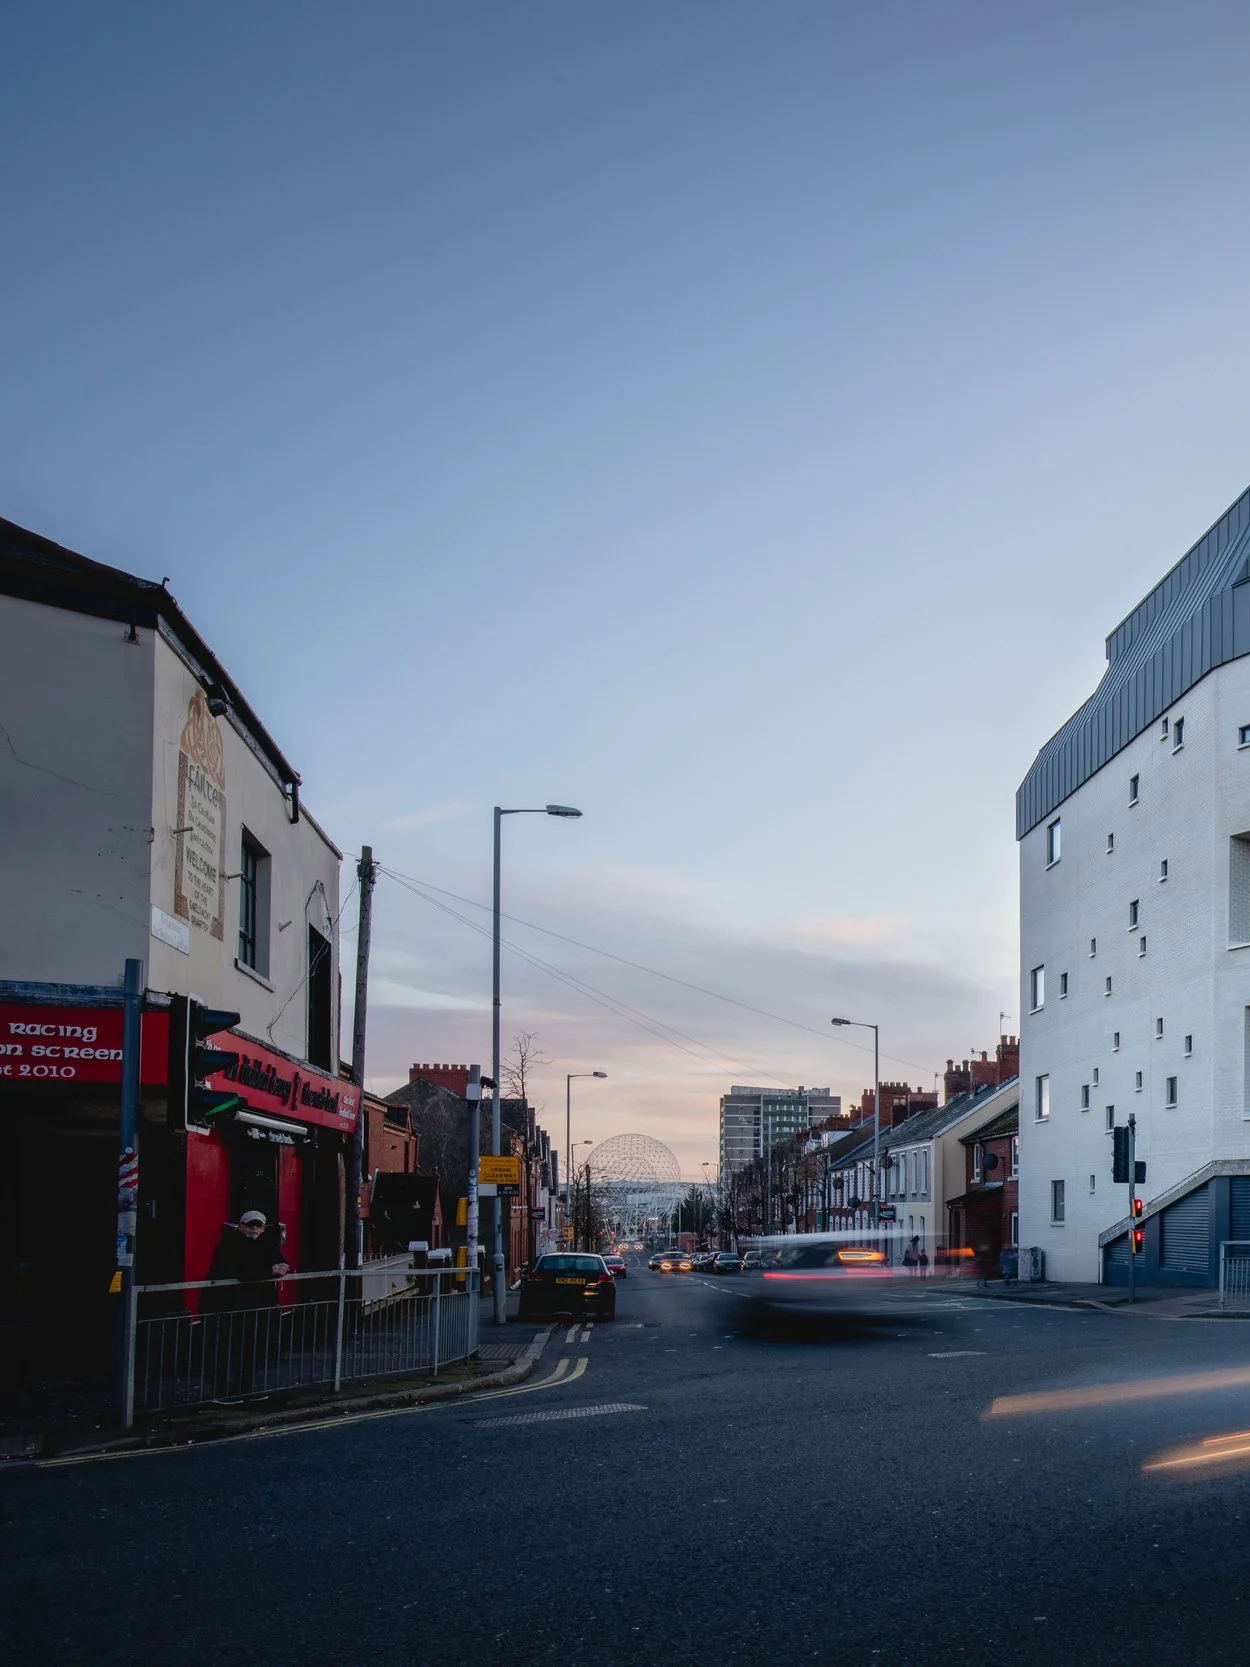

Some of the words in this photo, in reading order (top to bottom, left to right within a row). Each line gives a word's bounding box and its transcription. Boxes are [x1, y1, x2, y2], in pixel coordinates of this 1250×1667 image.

[186, 846, 216, 883] WELCOME
[187, 870, 193, 882] TO
[193, 874, 201, 888] THE
[18, 1064, 76, 1078] 2010
